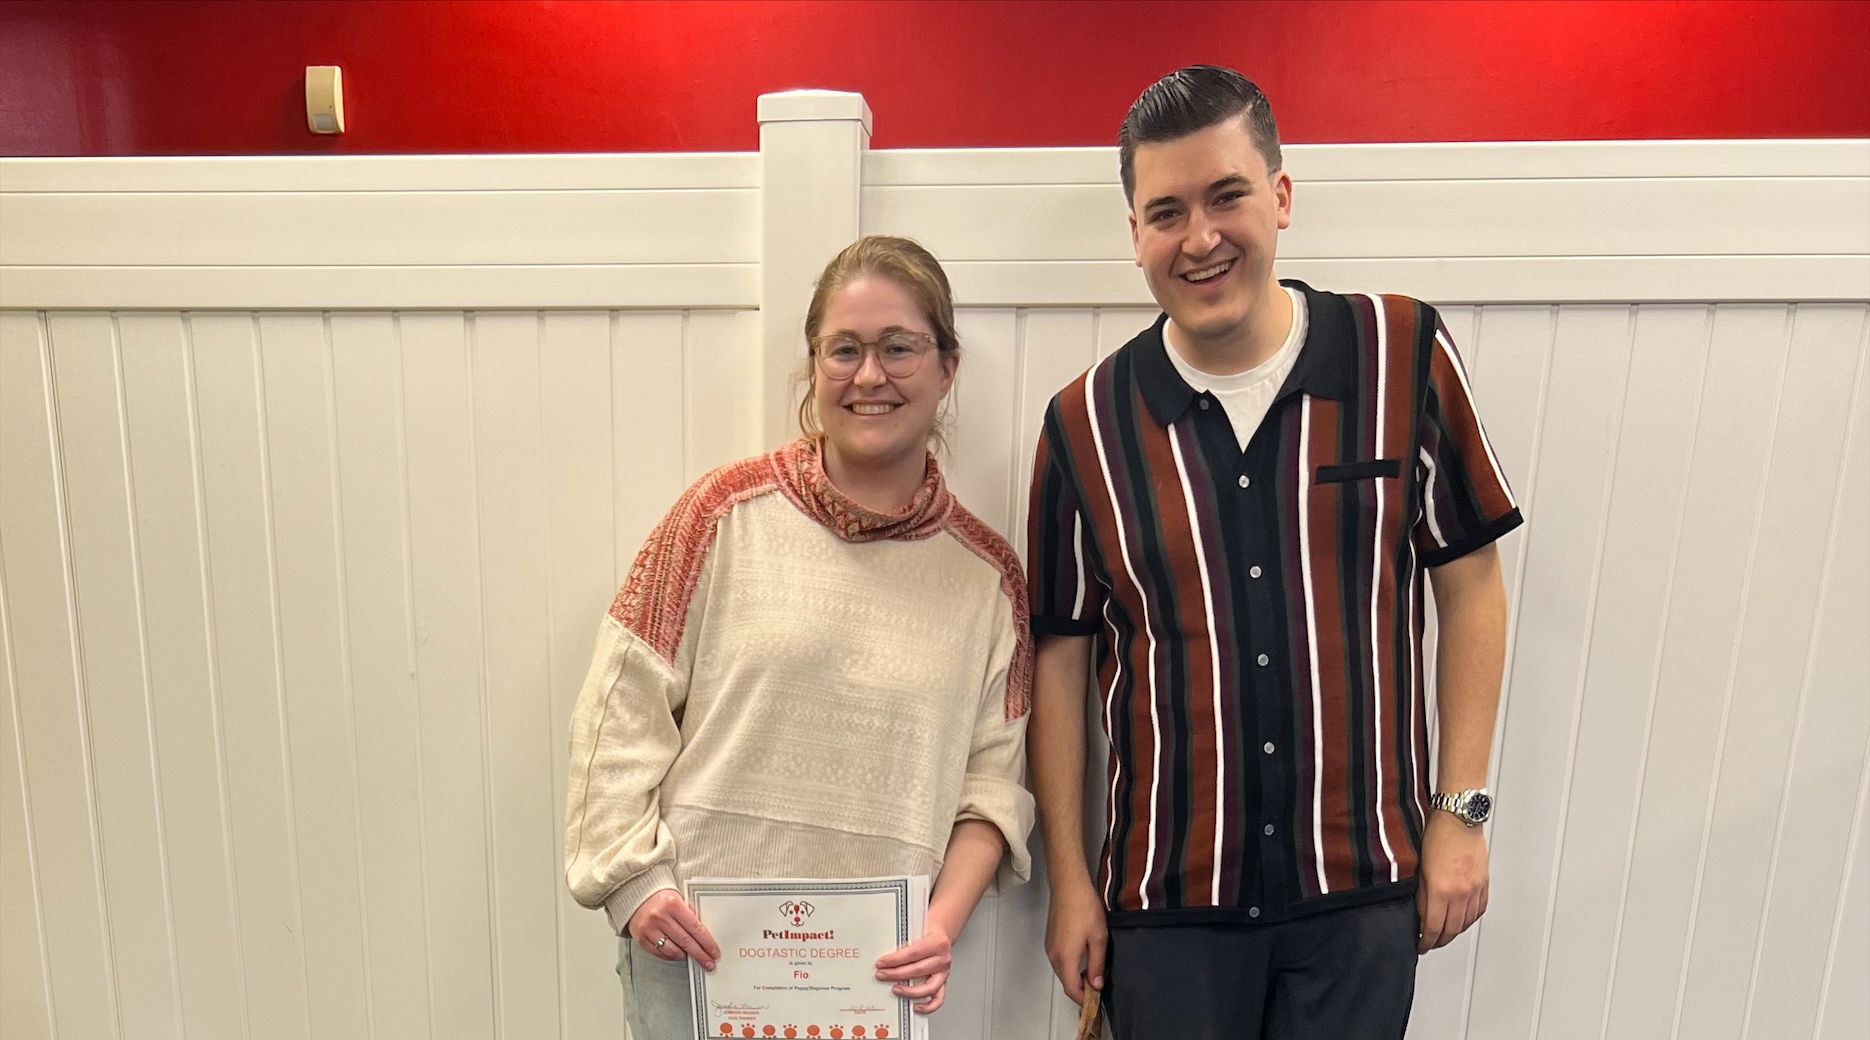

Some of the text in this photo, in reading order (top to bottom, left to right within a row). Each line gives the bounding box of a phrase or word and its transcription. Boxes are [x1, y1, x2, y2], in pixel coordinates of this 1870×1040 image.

[762, 929, 834, 942] PetImpact!
[739, 948, 860, 959] DOGTASTIC DEGREE
